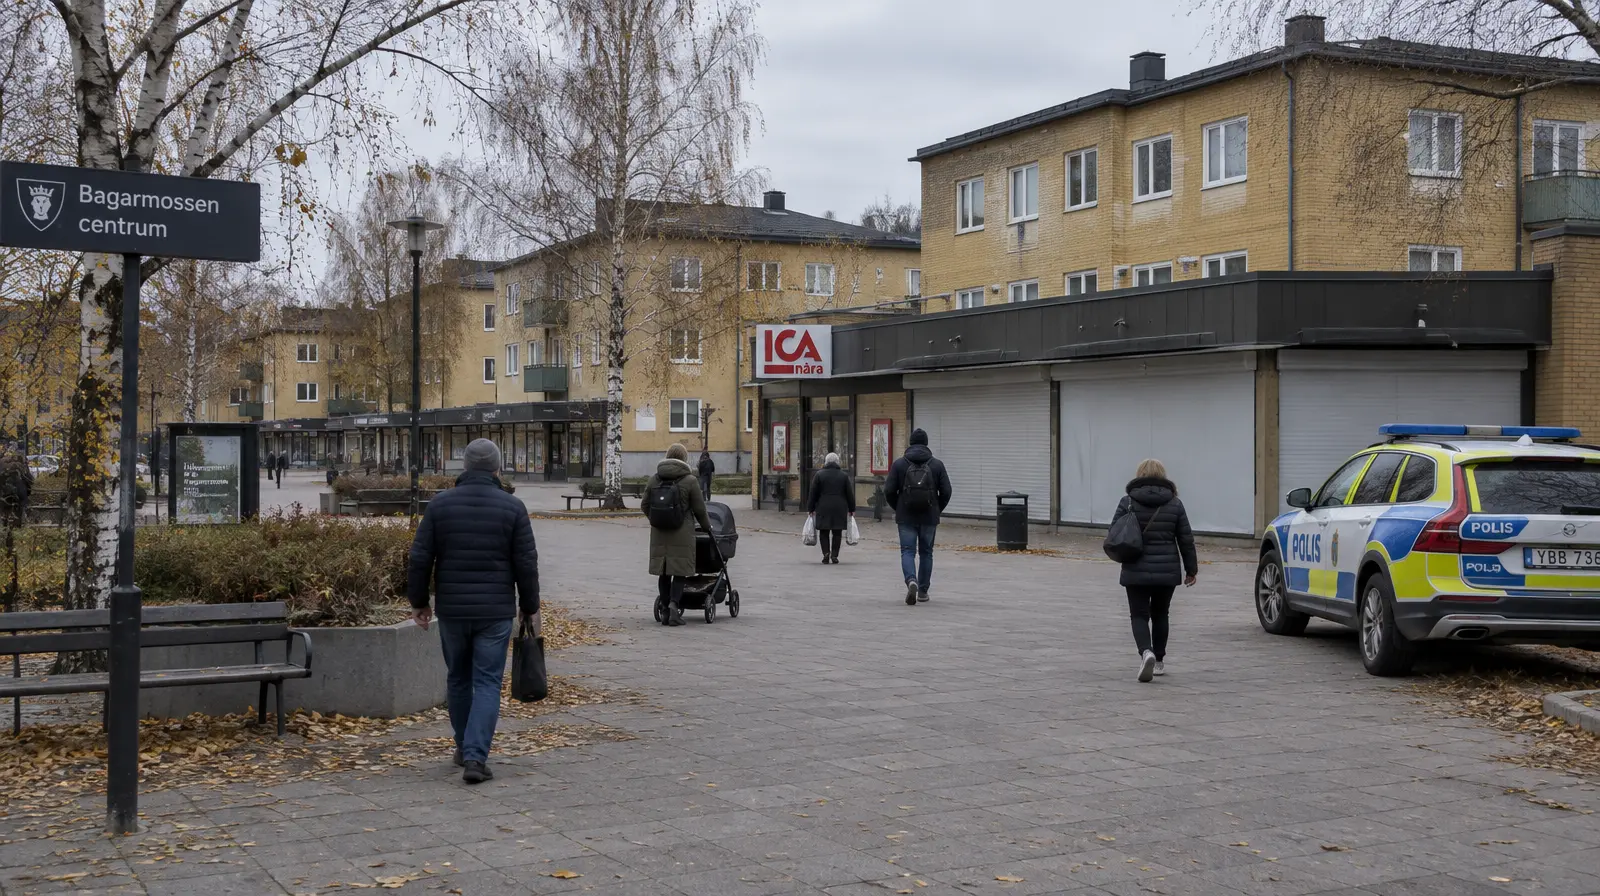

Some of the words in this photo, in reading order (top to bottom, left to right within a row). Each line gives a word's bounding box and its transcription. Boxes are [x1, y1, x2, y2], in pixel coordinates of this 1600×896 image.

[79, 184, 219, 214] Bagarmossen
[78, 217, 168, 238] centrum
[764, 329, 822, 362] ICA
[1471, 522, 1514, 534] POLIS
[1292, 533, 1321, 563] POLIS
[1537, 550, 1567, 565] YBB
[1573, 550, 1600, 565] 736
